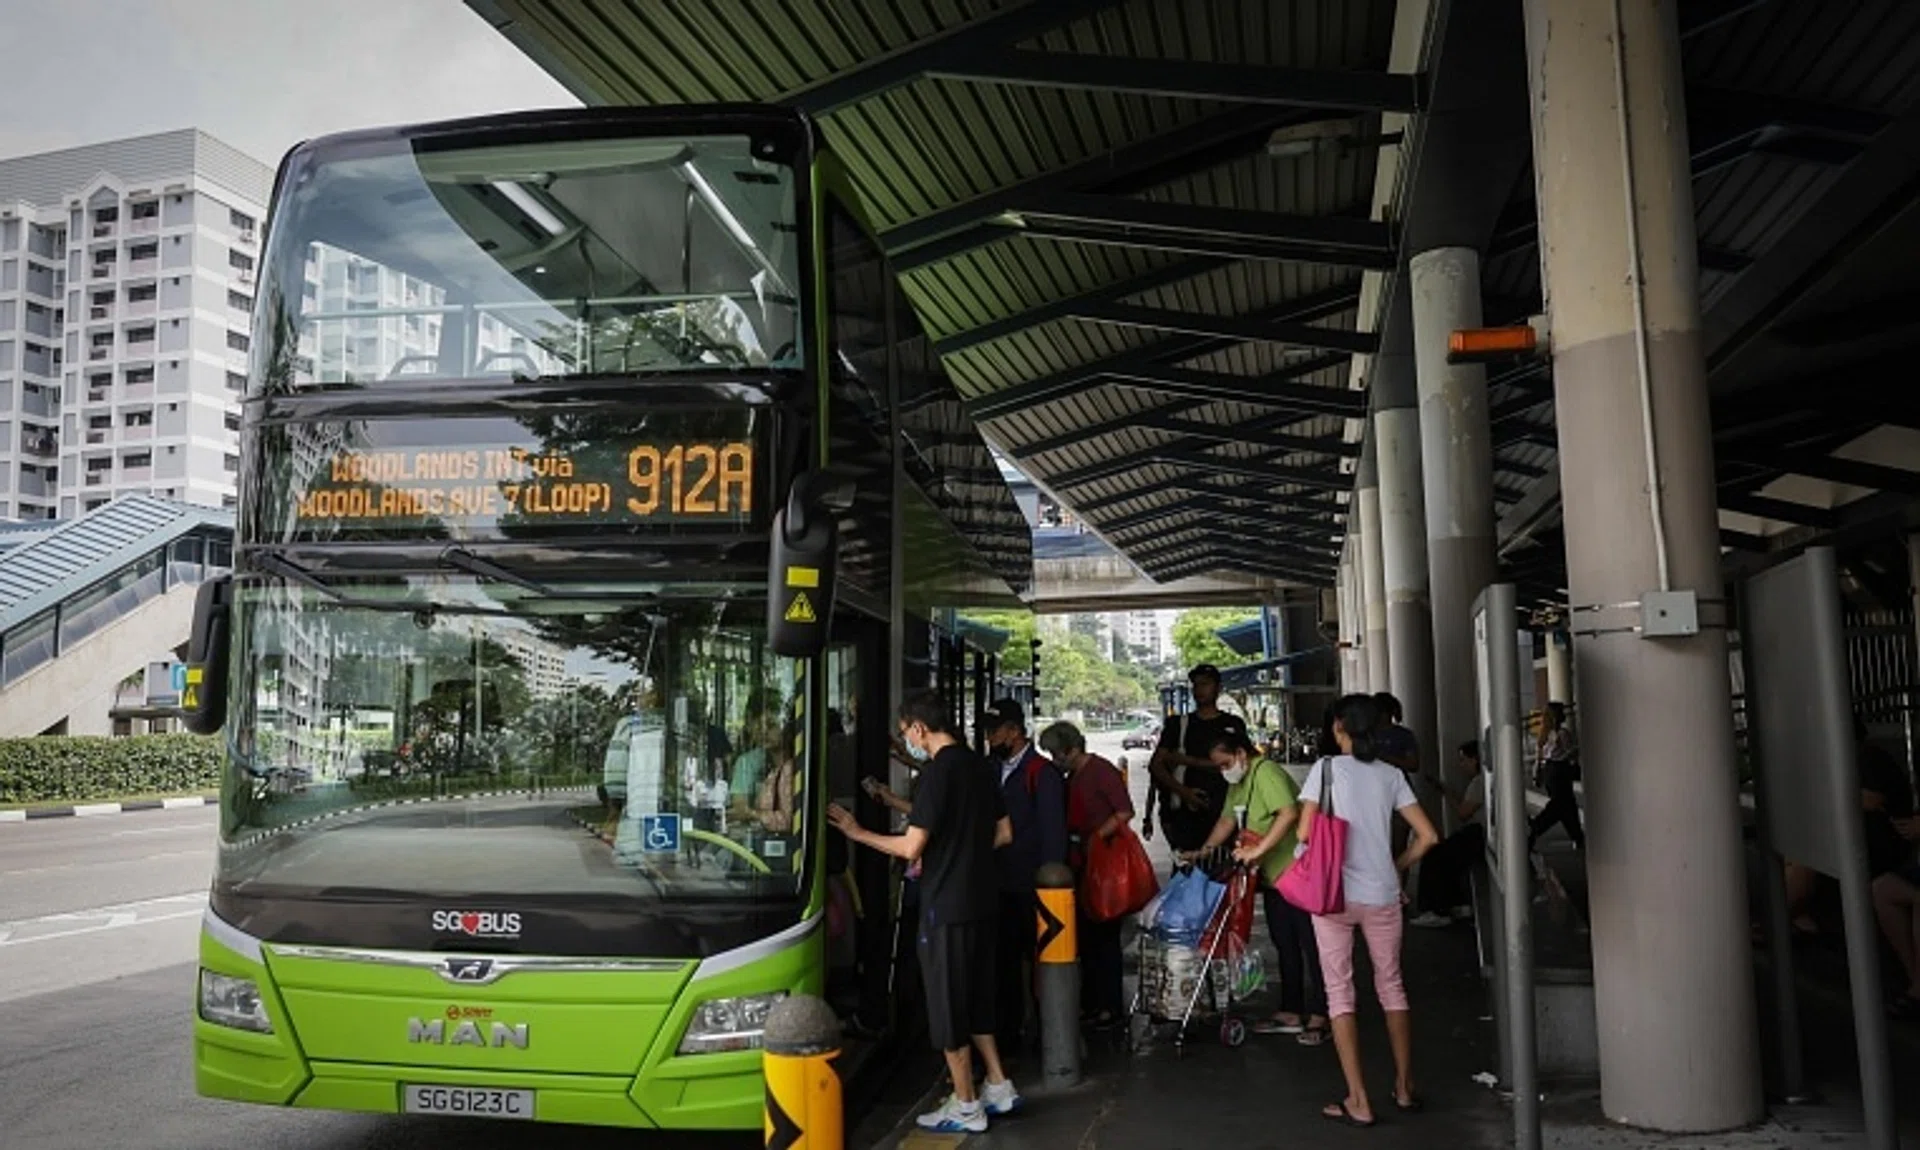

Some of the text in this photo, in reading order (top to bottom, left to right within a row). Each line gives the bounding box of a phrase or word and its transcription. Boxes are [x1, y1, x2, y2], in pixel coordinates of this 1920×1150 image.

[331, 448, 573, 482] WOODLANDS INT via
[627, 443, 752, 515] 912A
[297, 482, 611, 517] WOODLANDS AVE 7 (LOOP)
[407, 1017, 530, 1049] MAN
[417, 1088, 520, 1114] SG6123C
